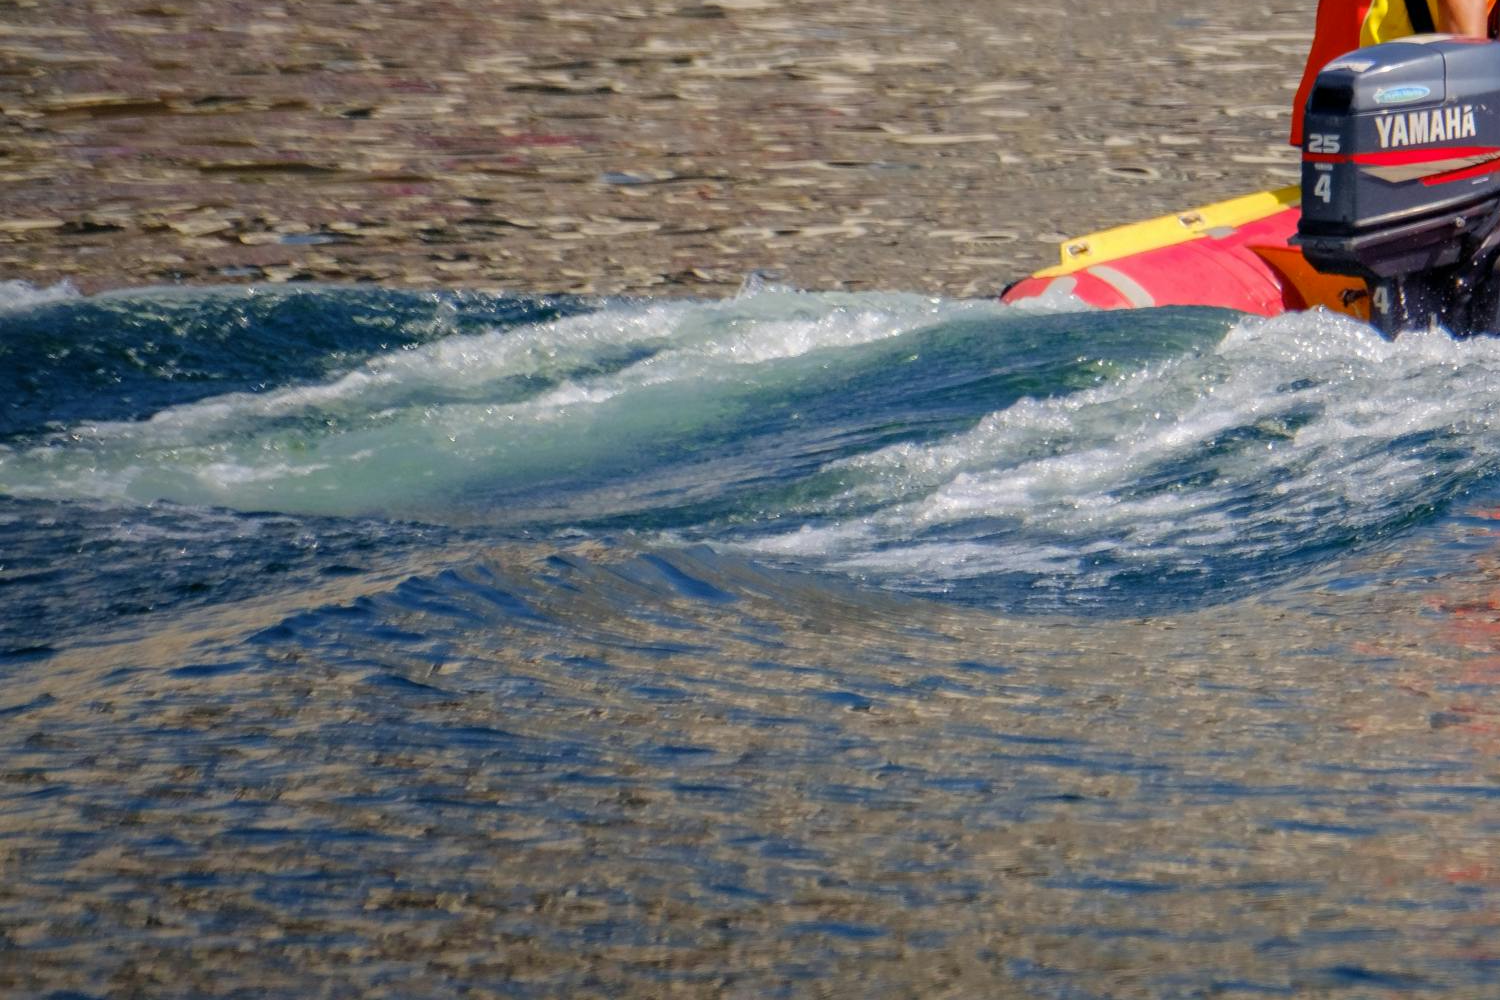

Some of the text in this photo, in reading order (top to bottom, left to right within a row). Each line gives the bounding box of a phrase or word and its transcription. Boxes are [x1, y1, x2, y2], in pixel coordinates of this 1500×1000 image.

[1375, 104, 1476, 148] YAMAHA
[1308, 133, 1340, 153] 25
[1314, 174, 1331, 203] 4
[1373, 287, 1390, 314] 4
